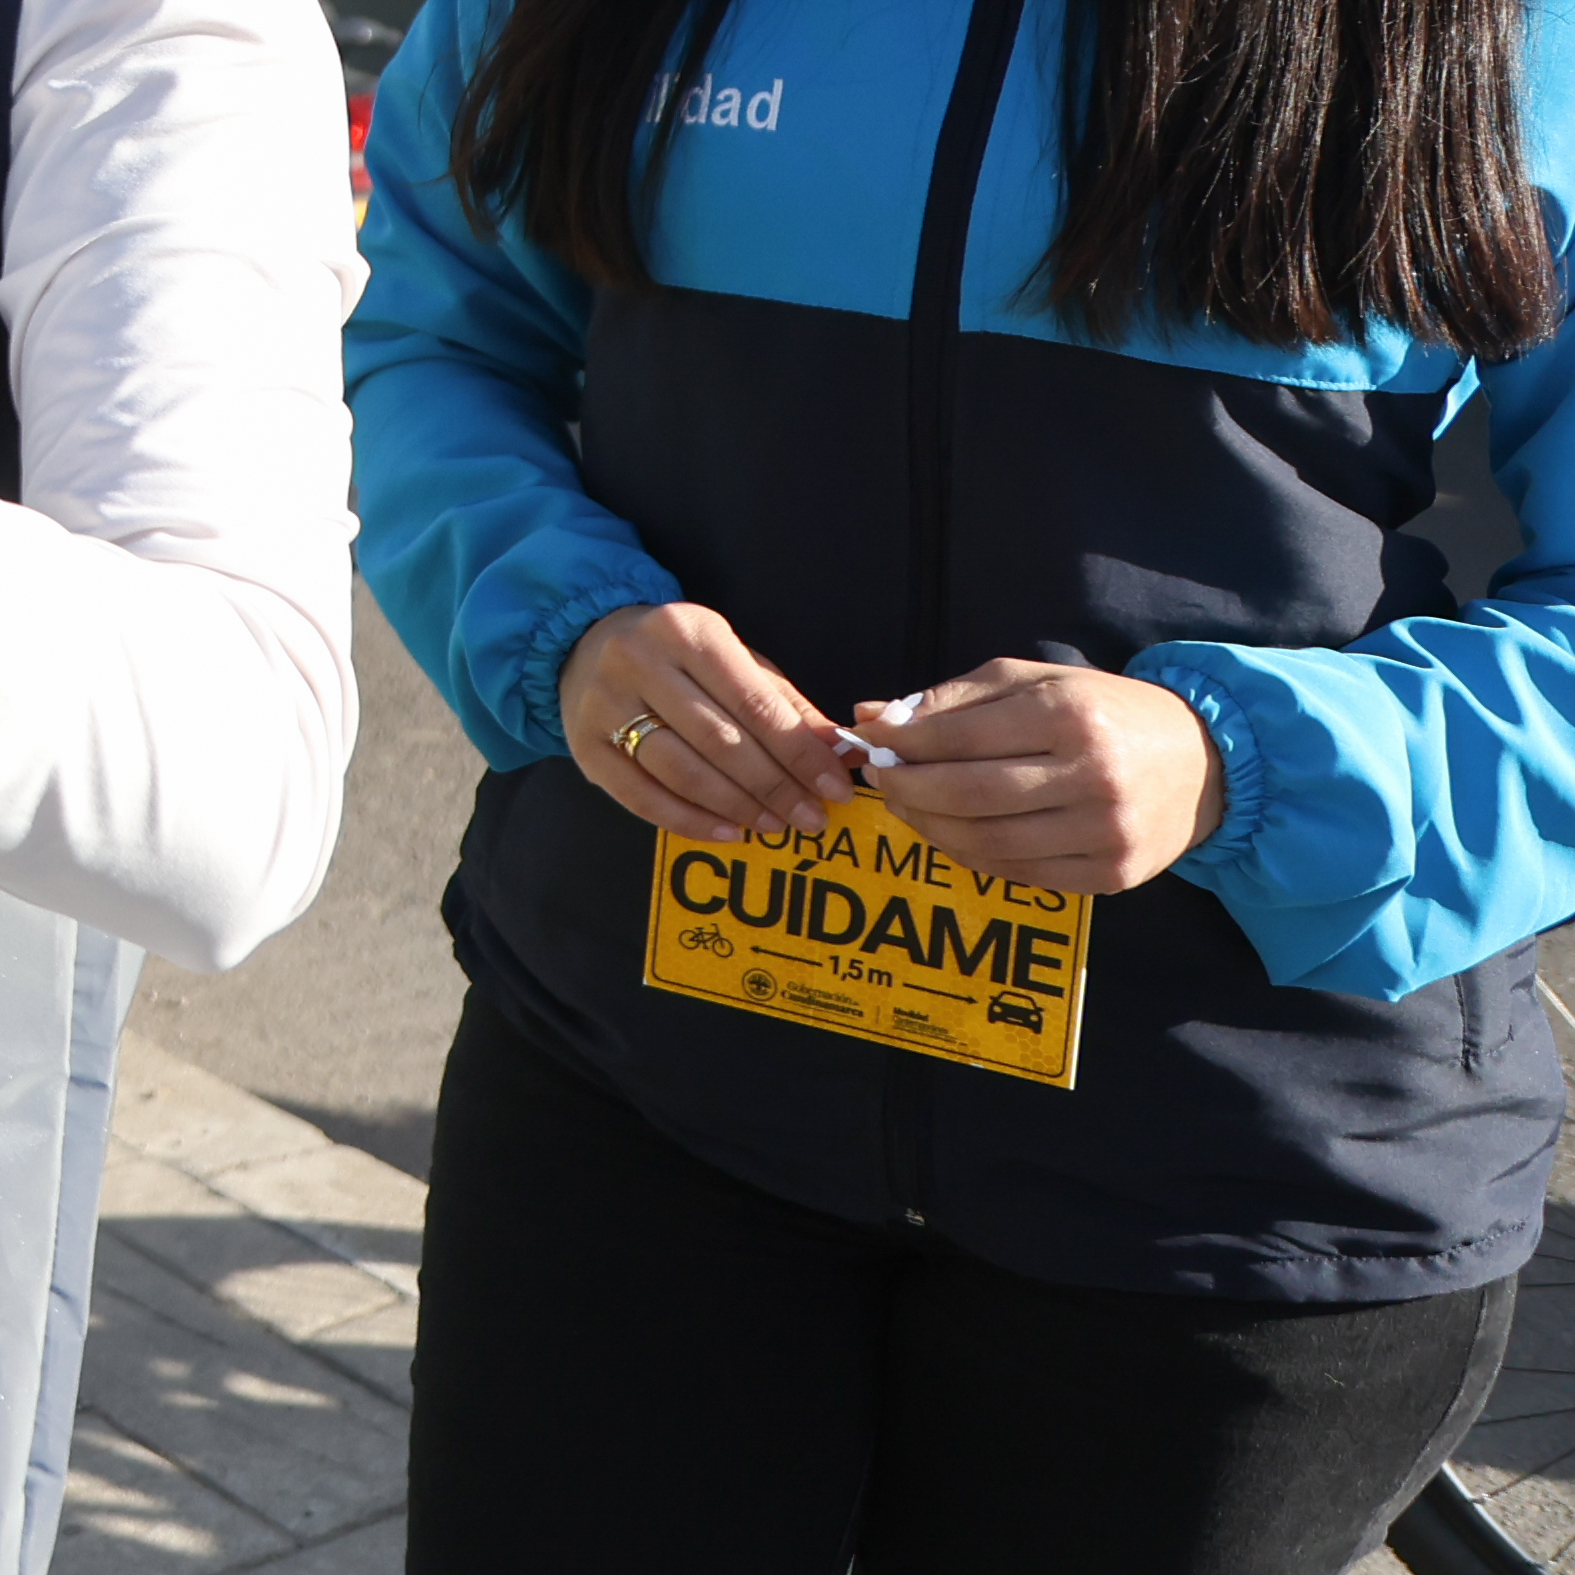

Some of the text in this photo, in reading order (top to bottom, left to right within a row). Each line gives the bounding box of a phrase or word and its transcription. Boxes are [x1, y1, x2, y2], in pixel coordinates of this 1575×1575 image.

[670, 850, 1070, 998] CUÍDAME
[875, 834, 952, 889] ME
[971, 870, 1068, 913] VES
